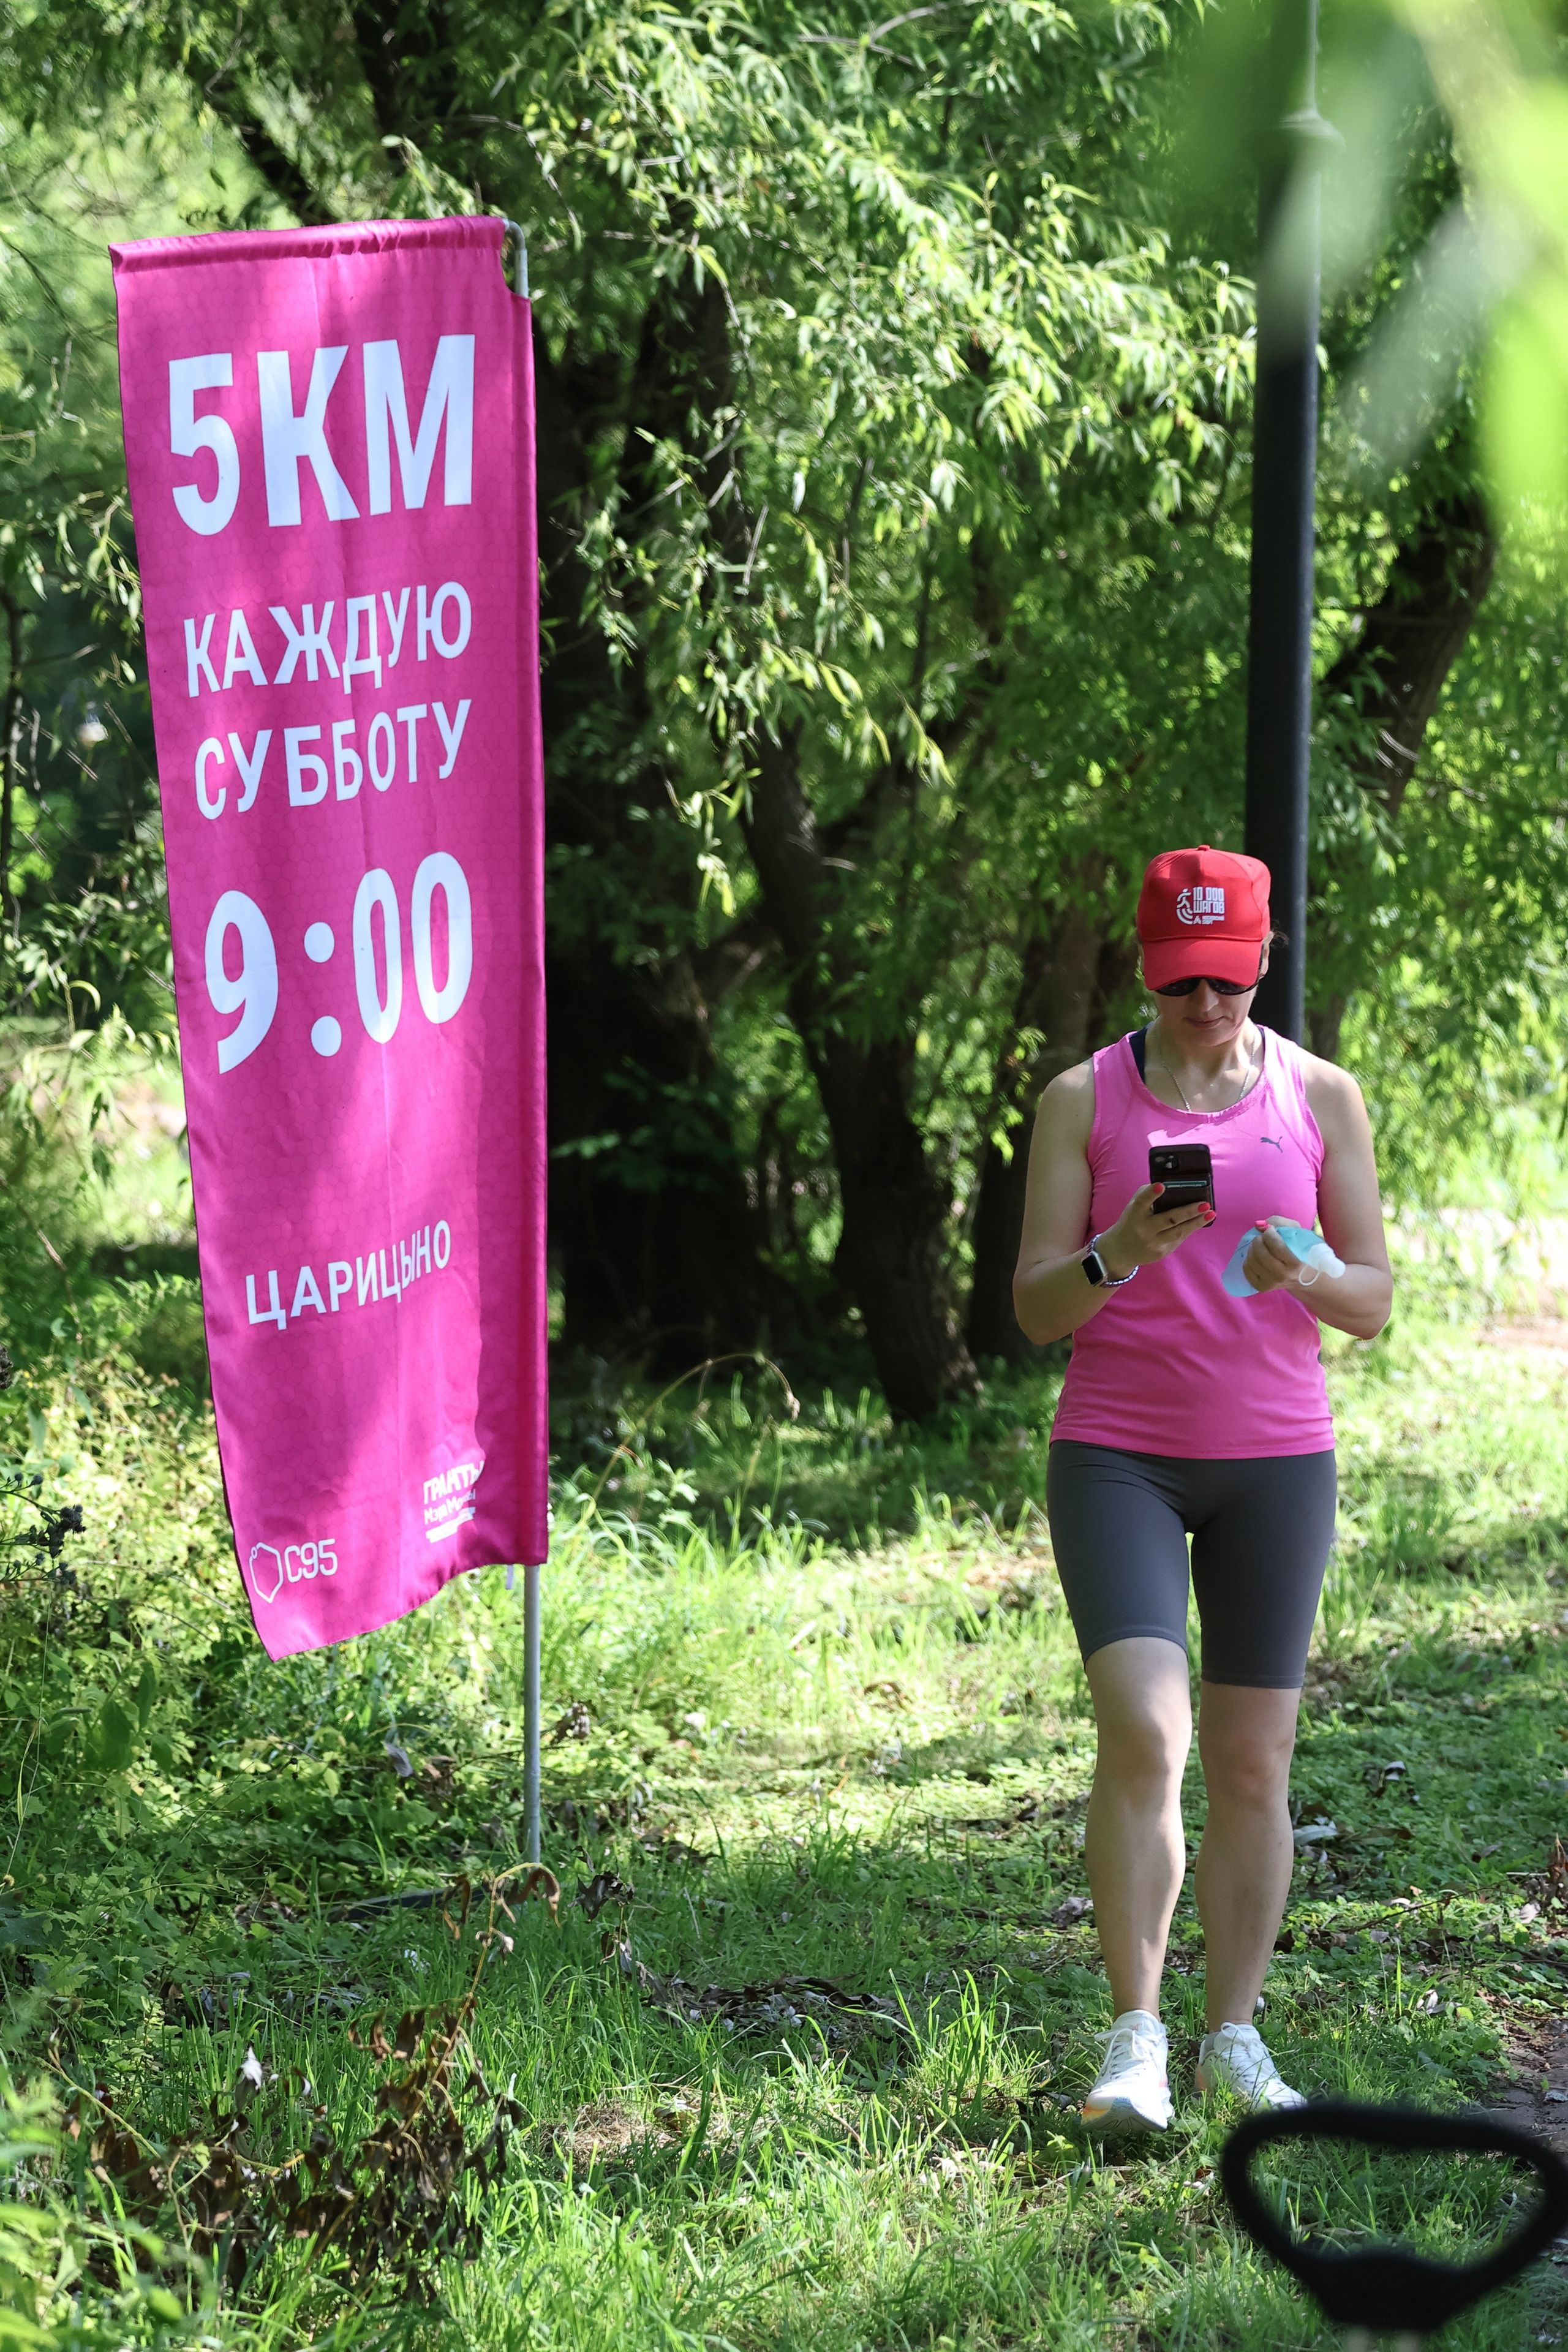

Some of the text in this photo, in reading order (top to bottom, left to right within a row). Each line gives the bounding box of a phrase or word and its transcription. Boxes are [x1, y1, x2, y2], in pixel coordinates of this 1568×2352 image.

[184, 581, 472, 698] КАЖДУЮ
[195, 699, 472, 820] СУББОТУ
[205, 851, 473, 1074] 9:00
[1193, 900, 1225, 914] ШАГОВ
[246, 1220, 451, 1330] ЦАРИЦЫНО
